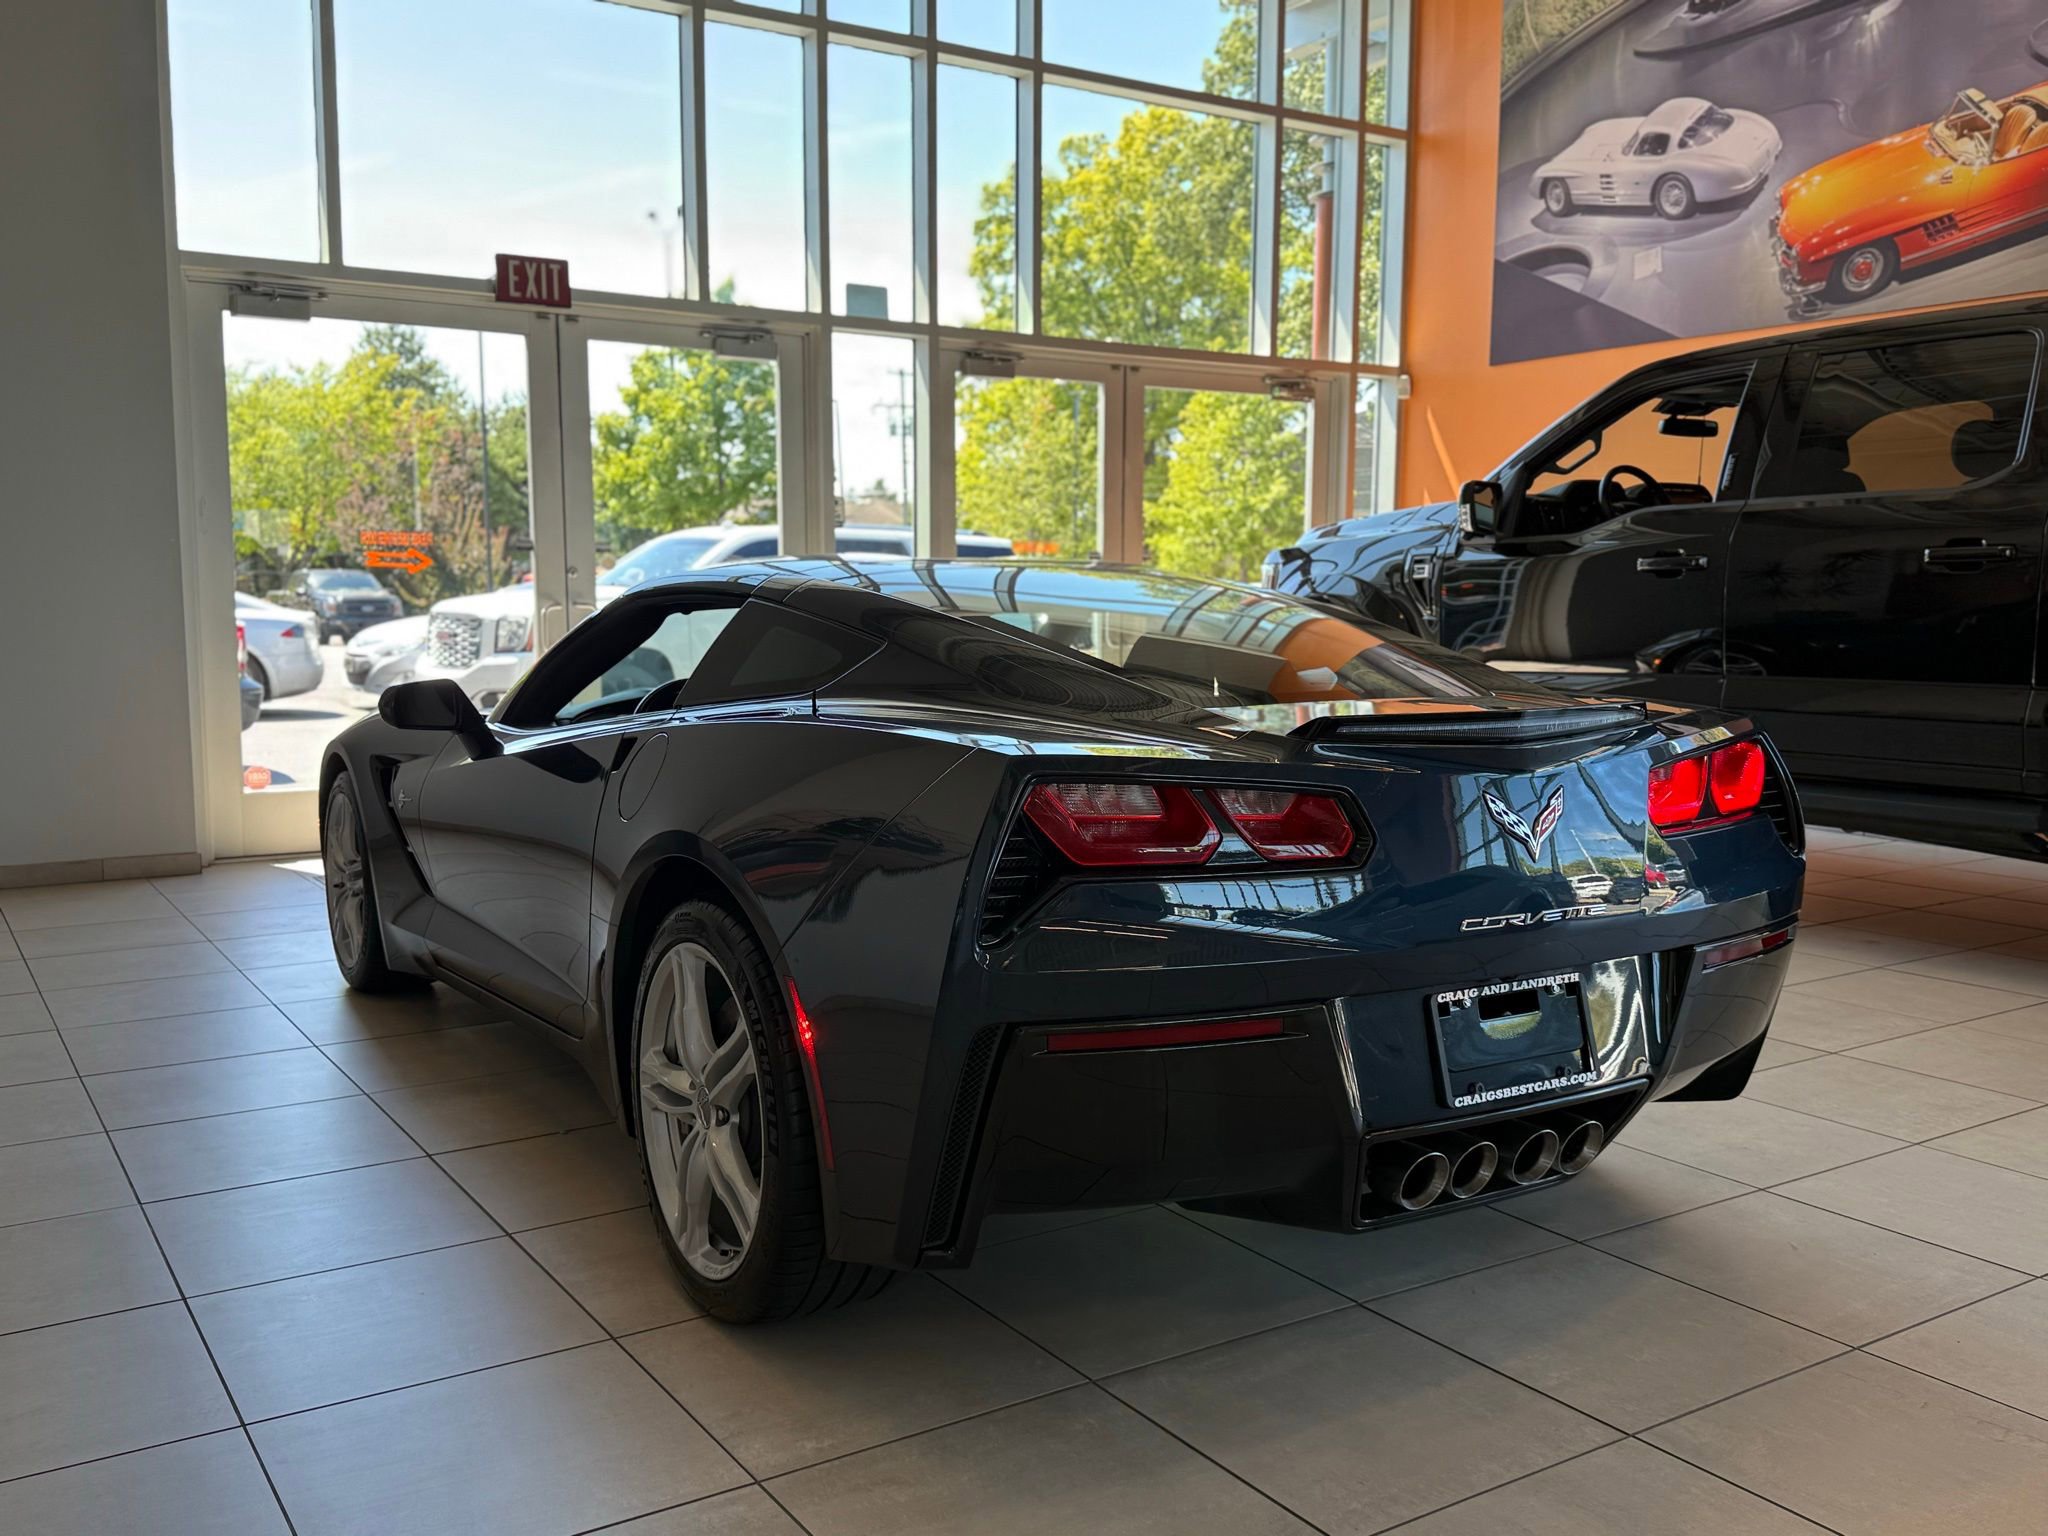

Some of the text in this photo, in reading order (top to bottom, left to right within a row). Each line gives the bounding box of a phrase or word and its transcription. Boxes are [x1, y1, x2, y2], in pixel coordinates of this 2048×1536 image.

[508, 259, 561, 301] EXIT
[1460, 904, 1608, 931] CORVETTE
[1437, 973, 1580, 1003] CRAIG AND LANDRETH
[745, 999, 779, 1156] MICHELIN
[1454, 1070, 1597, 1108] CRAIGSBESTCARS.COM
